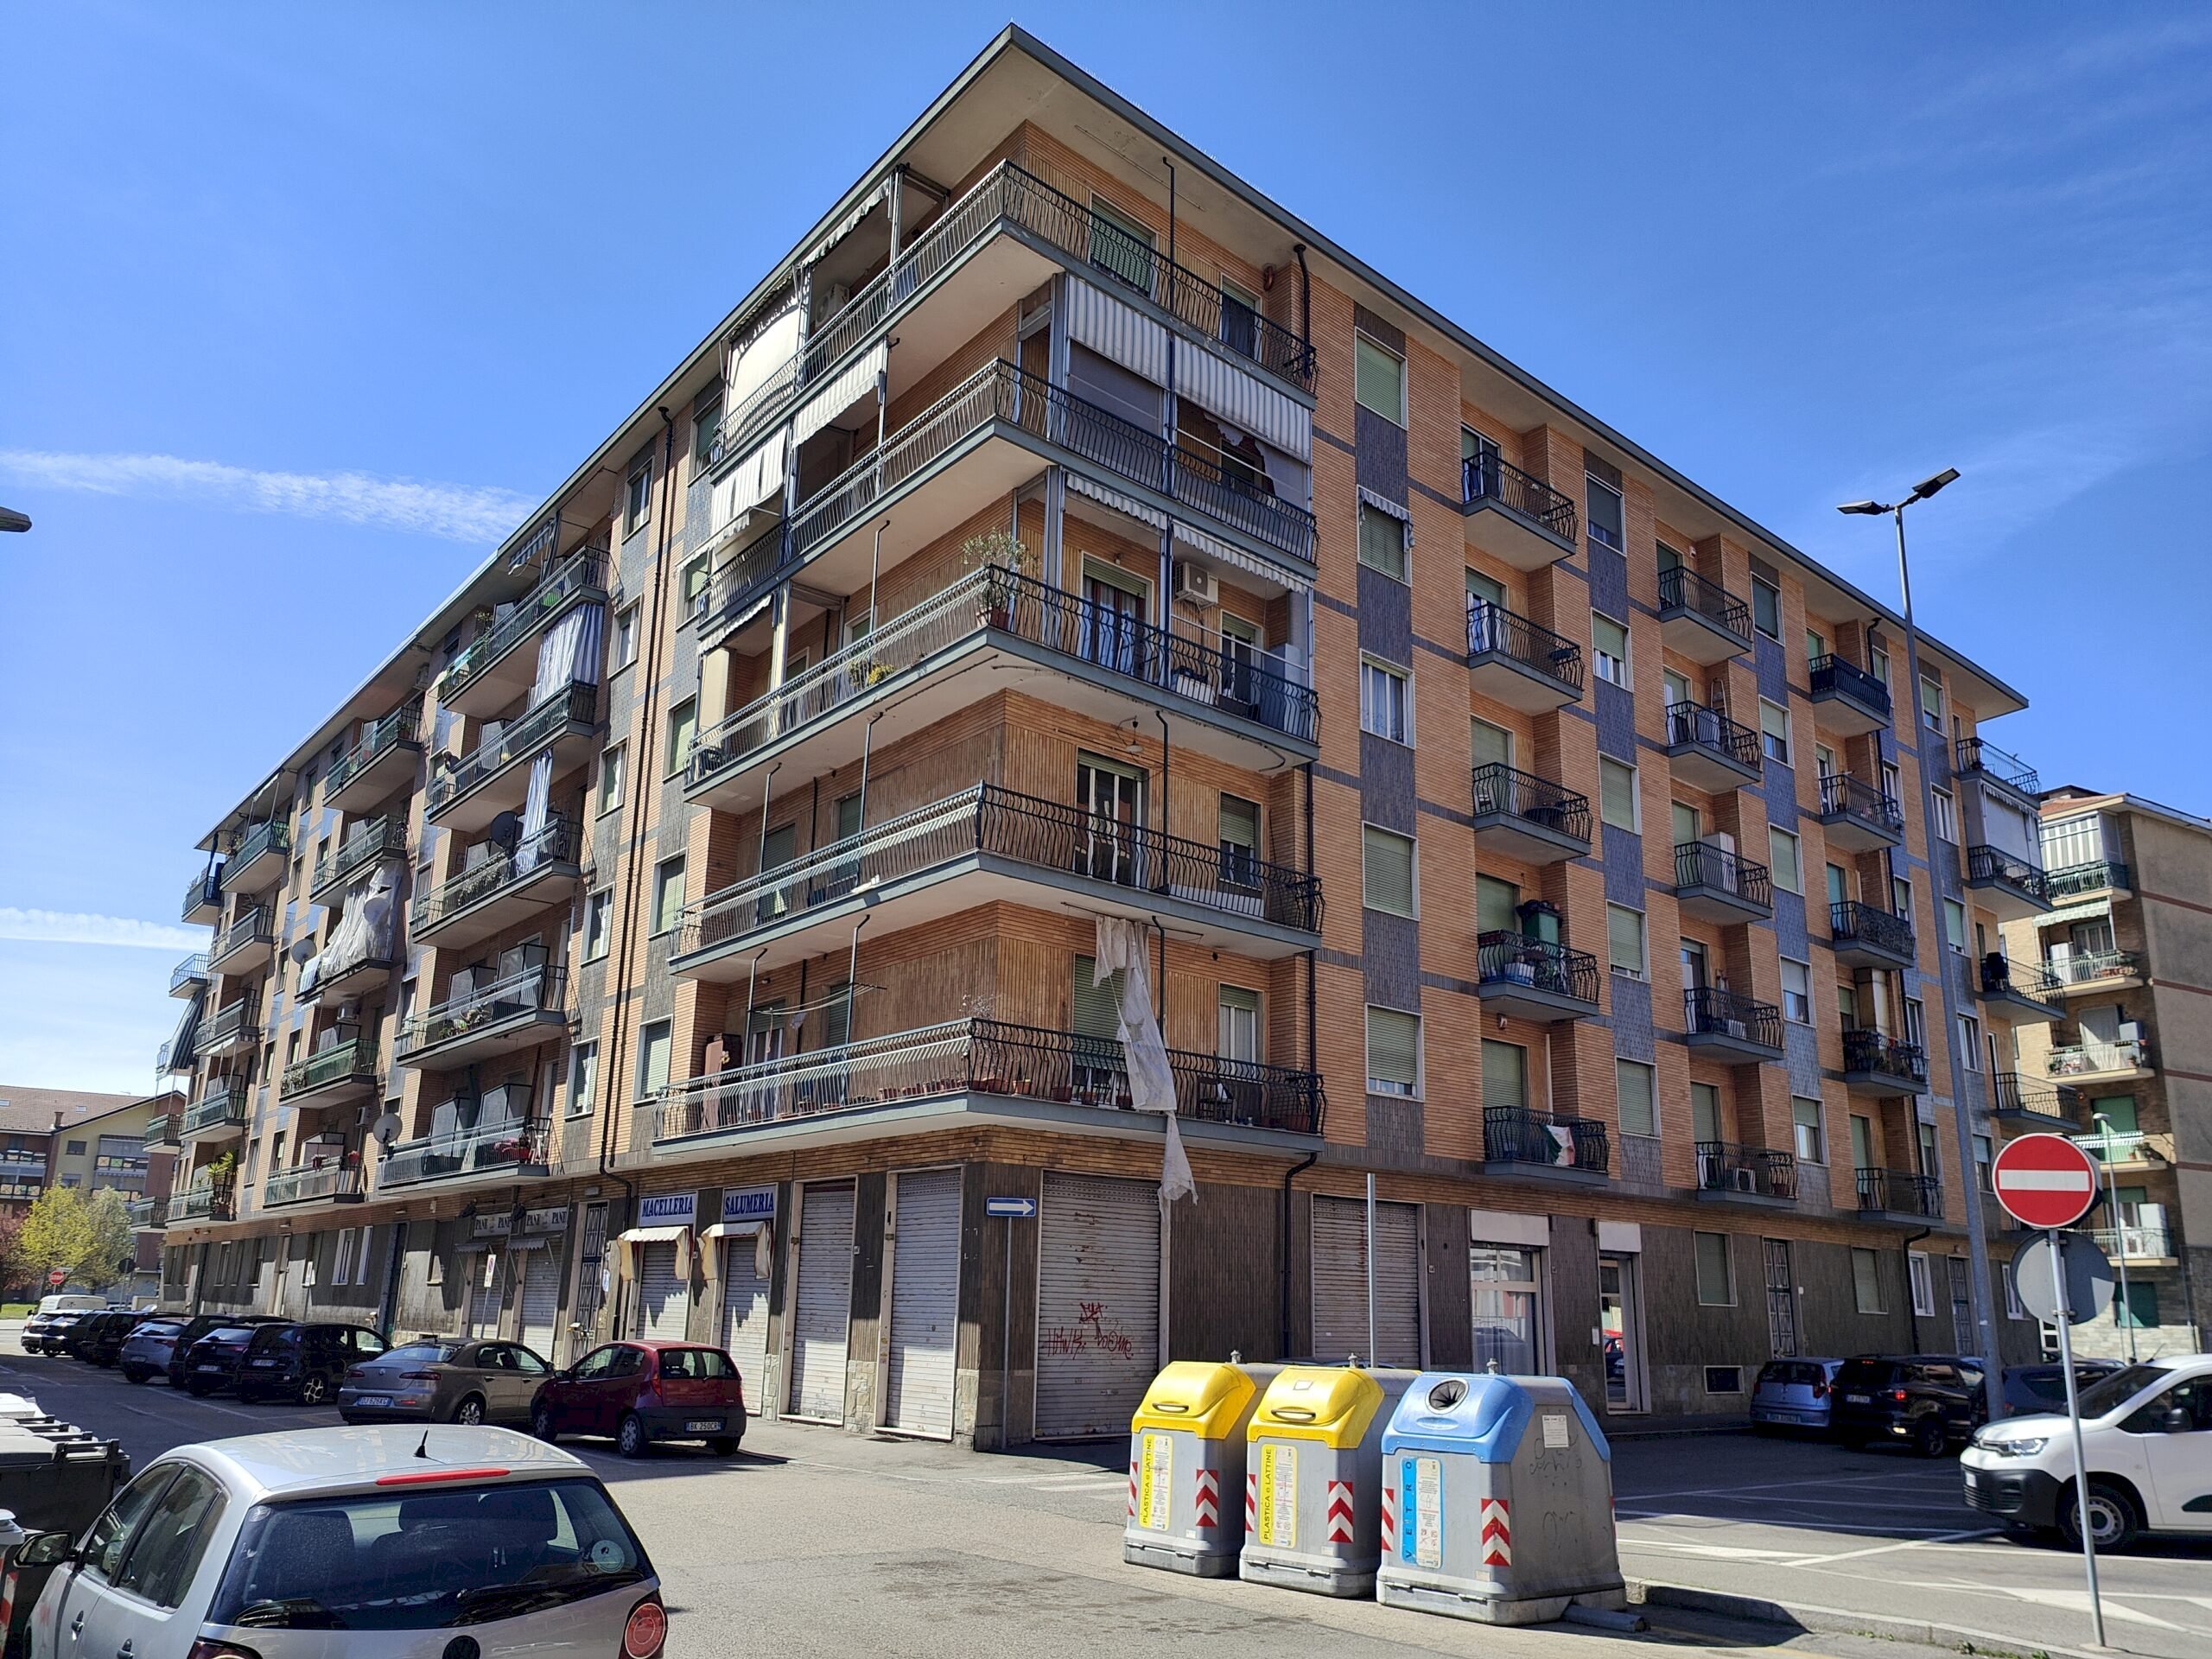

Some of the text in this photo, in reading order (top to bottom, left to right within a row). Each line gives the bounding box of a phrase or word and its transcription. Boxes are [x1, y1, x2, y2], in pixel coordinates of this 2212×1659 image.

[641, 1196, 693, 1217] MACELLERIA
[725, 1192, 774, 1216] SALUMERIA
[1142, 1482, 1151, 1523] PLASTICA
